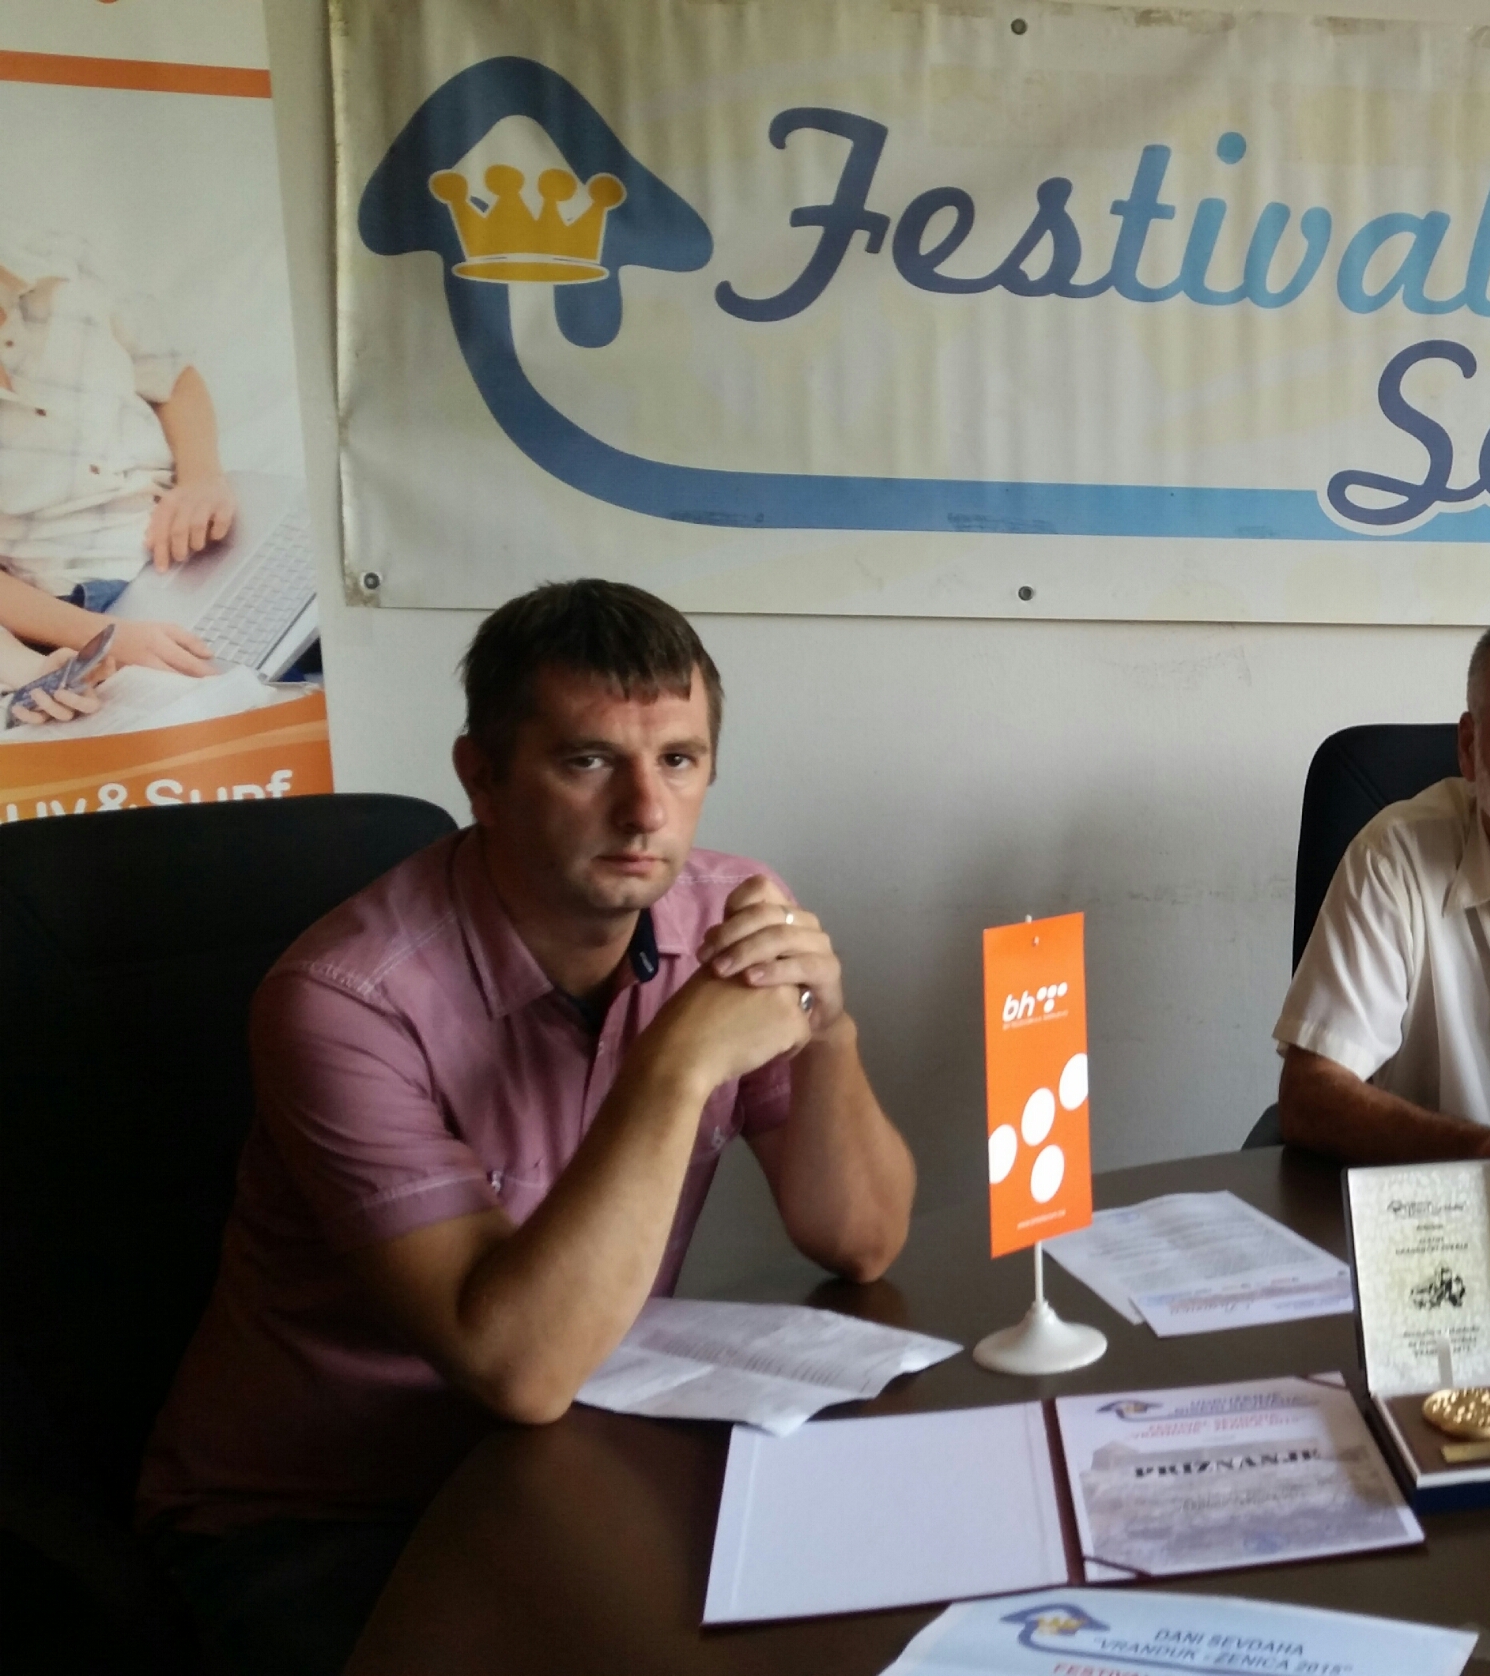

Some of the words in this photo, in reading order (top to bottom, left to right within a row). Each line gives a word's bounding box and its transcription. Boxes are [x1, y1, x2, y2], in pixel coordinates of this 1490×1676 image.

[1154, 1628, 1205, 1645] DANI
[1206, 1633, 1304, 1656] SEVDAHA
[1213, 1651, 1289, 1671] ZENICA
